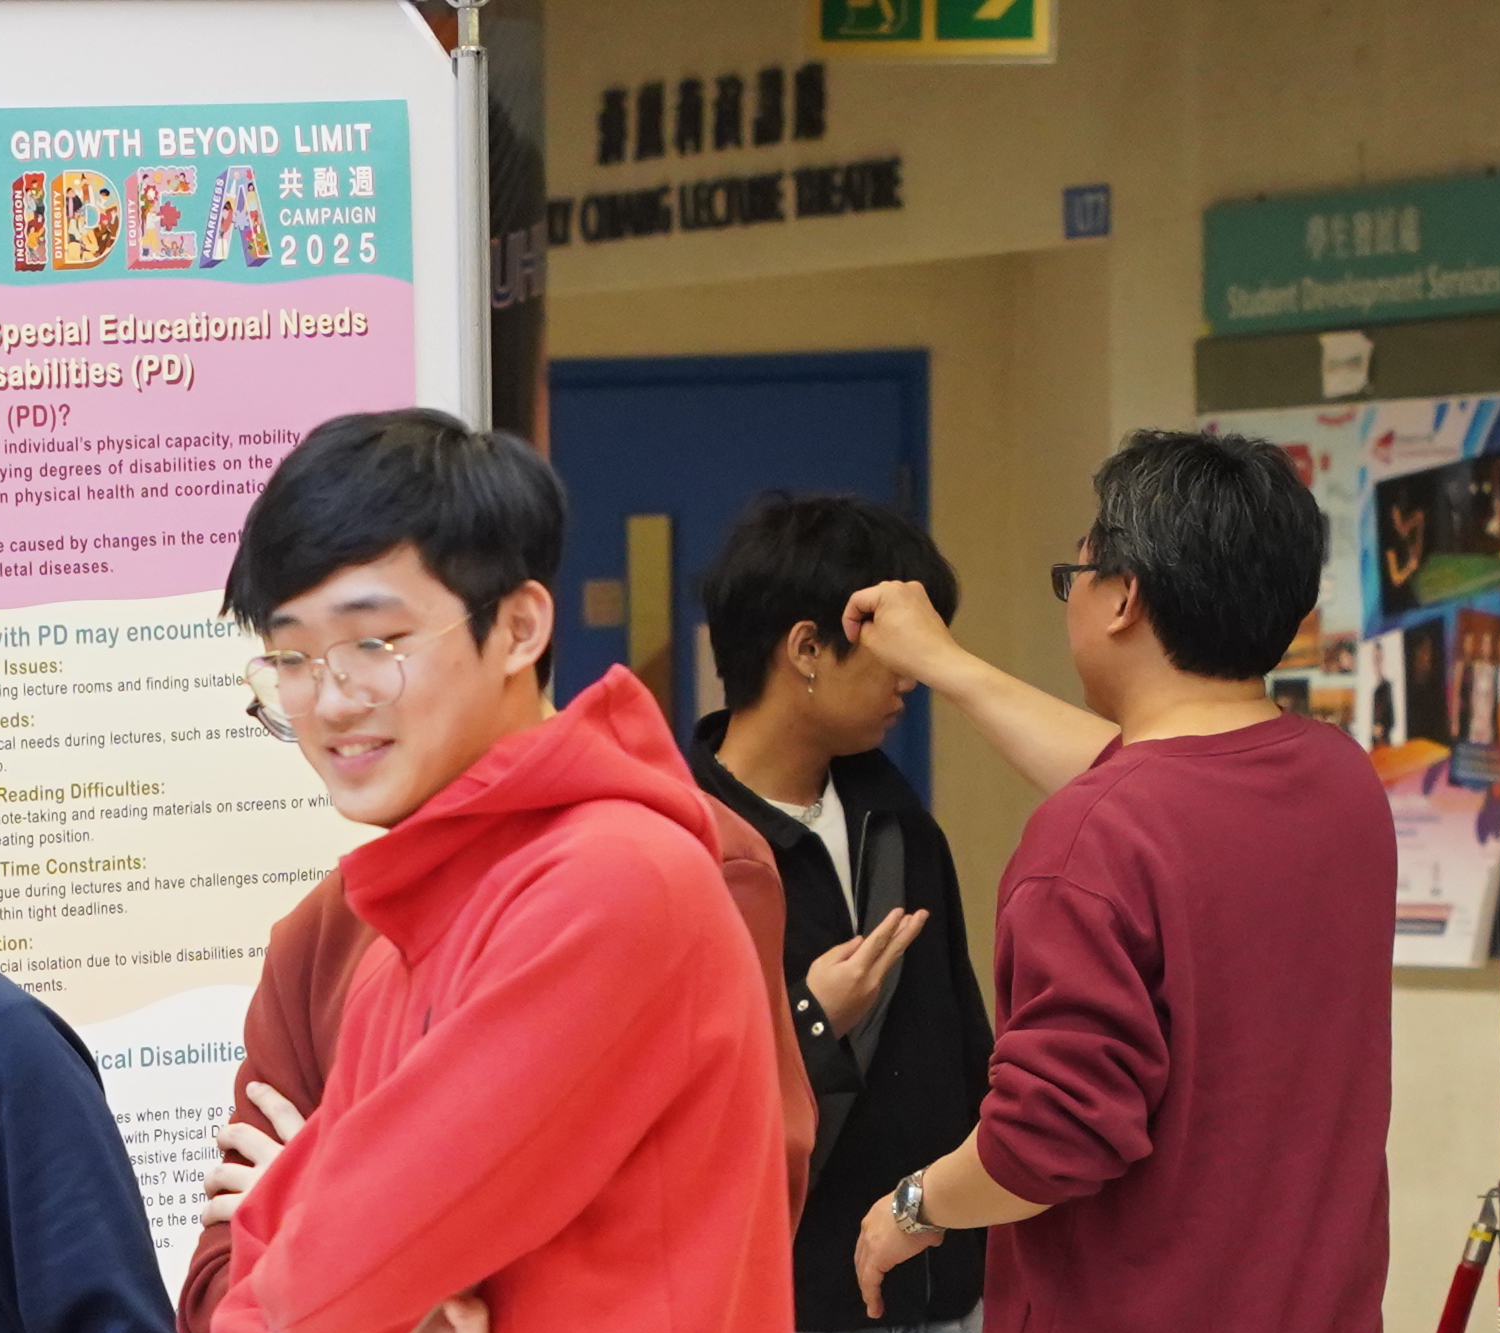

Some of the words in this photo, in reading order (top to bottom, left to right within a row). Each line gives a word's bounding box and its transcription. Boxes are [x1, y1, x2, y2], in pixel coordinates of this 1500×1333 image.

[279, 166, 375, 198] 共融週
[279, 207, 376, 226] CAMPAIGN
[279, 233, 377, 266] 2025
[132, 354, 195, 389] (PD)
[3, 658, 63, 677] Issues:
[71, 780, 165, 799] Difficulties:
[0, 860, 41, 877] Time
[46, 855, 146, 874] Constraints:
